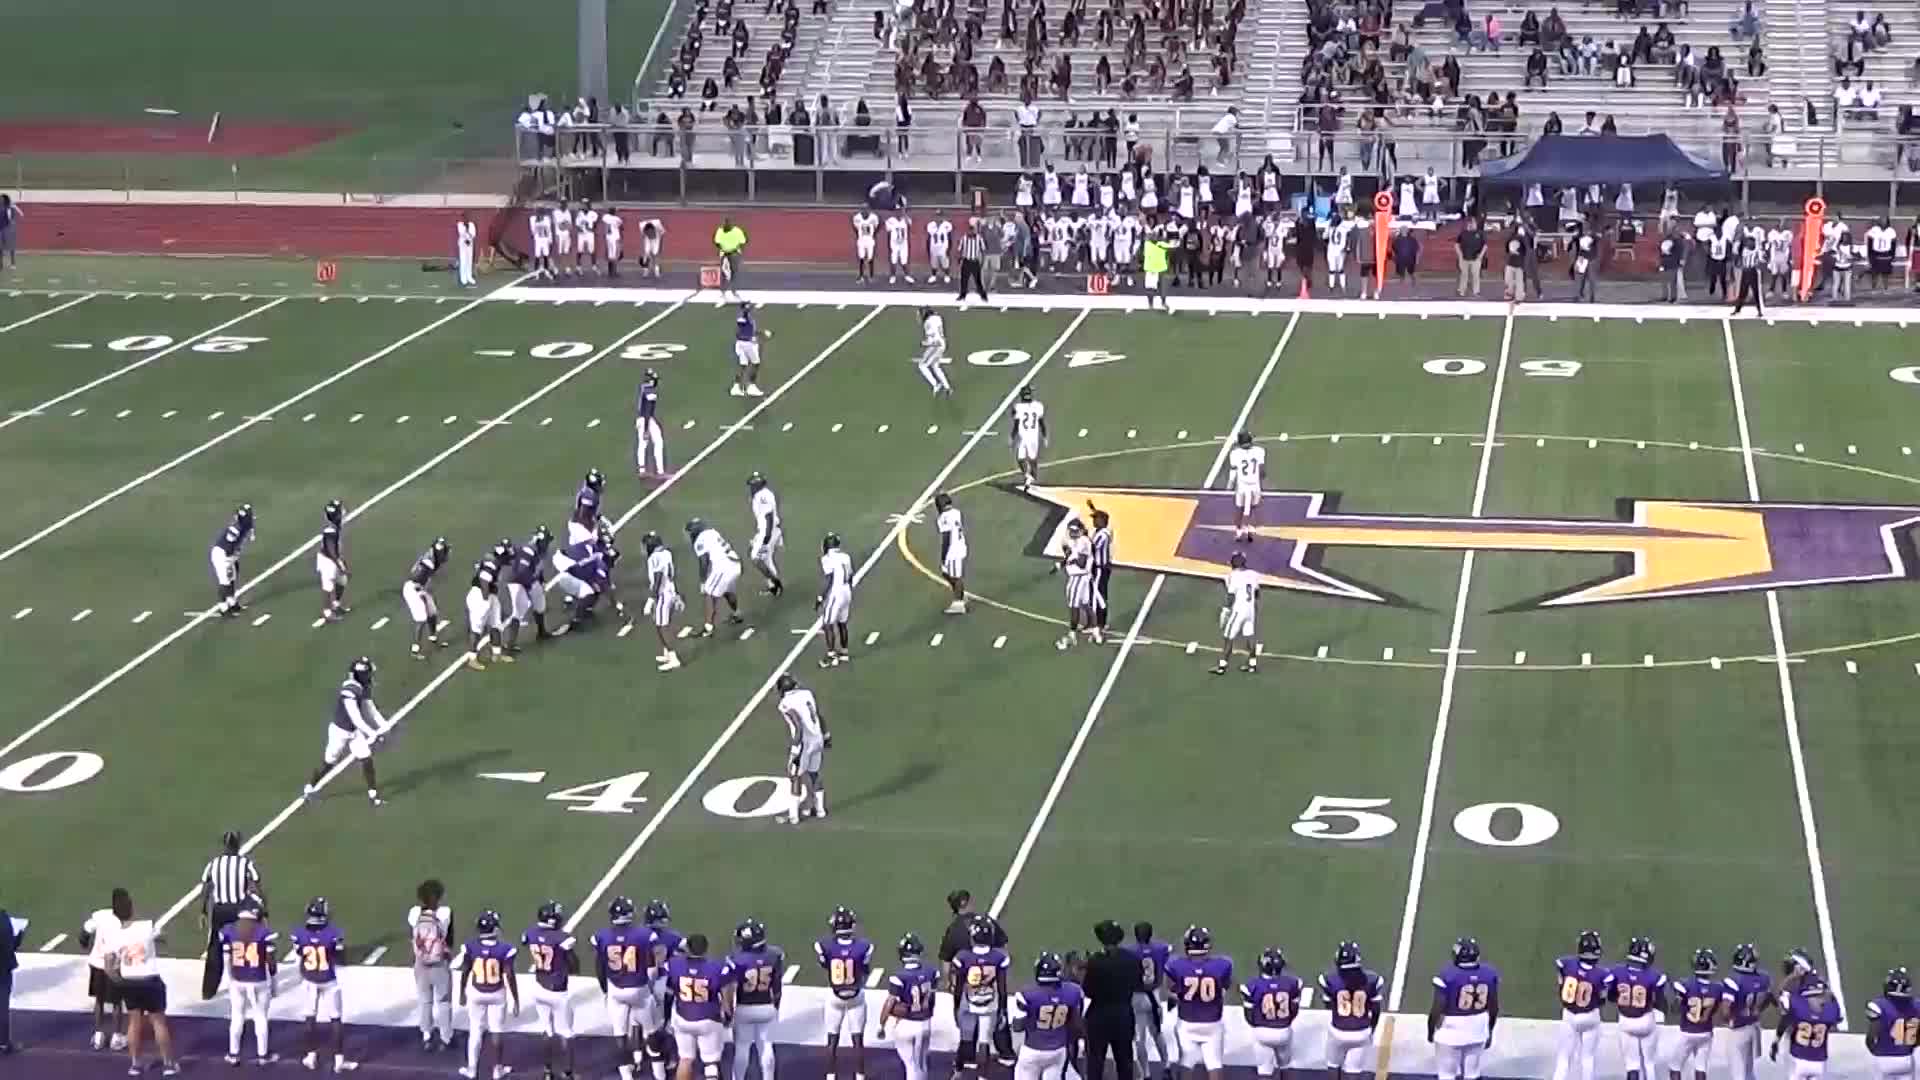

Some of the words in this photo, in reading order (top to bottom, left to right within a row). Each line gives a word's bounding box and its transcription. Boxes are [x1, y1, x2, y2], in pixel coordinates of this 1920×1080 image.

[1423, 358, 1583, 377] 50
[1022, 411, 1038, 430] 23
[1240, 457, 1257, 476] 27
[545, 772, 806, 818] 40
[1290, 796, 1559, 846] 50
[232, 941, 259, 968] 24
[303, 945, 330, 971] 31
[607, 945, 637, 972] 54
[472, 957, 500, 984] 40
[679, 976, 709, 1002] 55
[1183, 977, 1215, 1003] 70
[1458, 984, 1488, 1010] 63
[1261, 992, 1290, 1019] 43
[1686, 997, 1716, 1023] 37
[1795, 1021, 1827, 1048] 23
